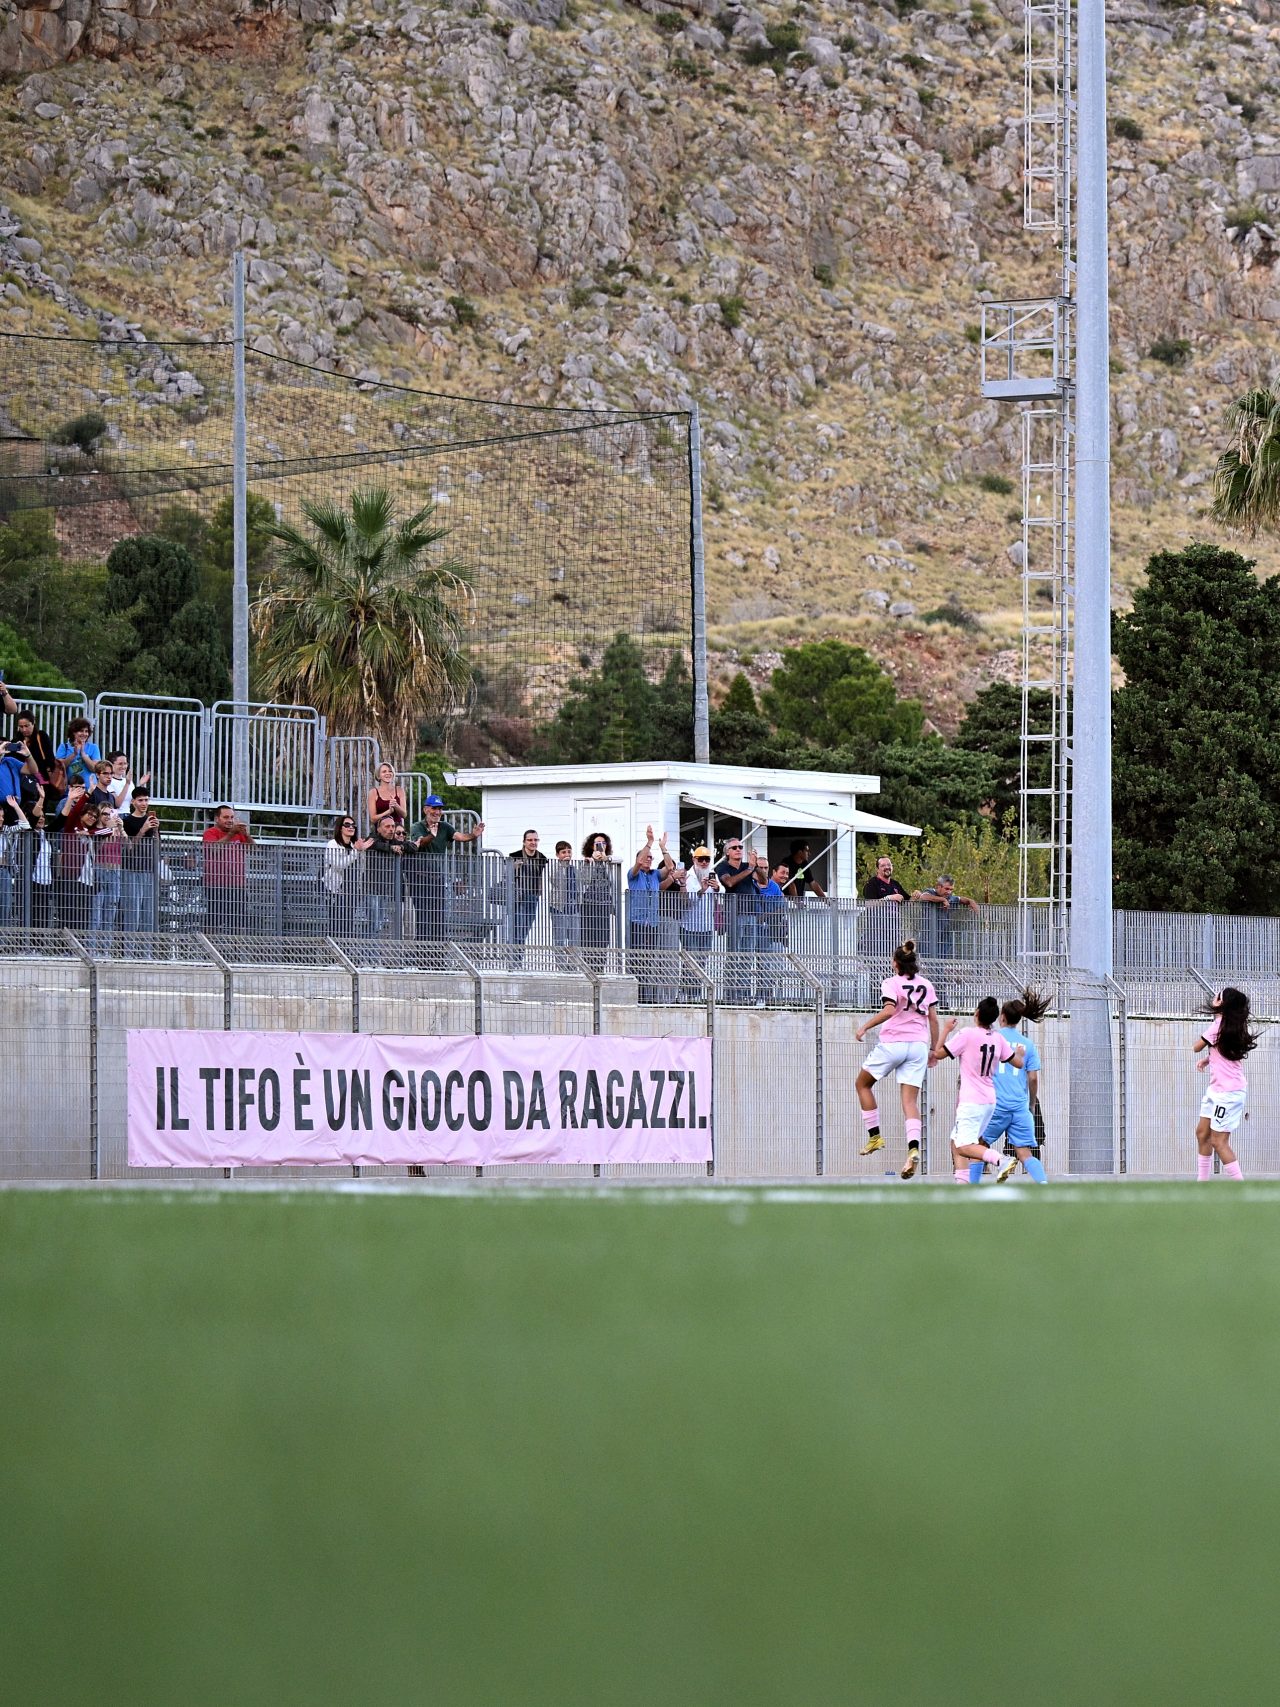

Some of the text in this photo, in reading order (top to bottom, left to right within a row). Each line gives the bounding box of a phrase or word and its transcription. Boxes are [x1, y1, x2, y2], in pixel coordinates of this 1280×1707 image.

[980, 1043, 995, 1077] 11
[156, 1052, 707, 1132] IL TIFO È UN GIOCO DA RAGAZZI.
[1213, 1104, 1226, 1119] 10
